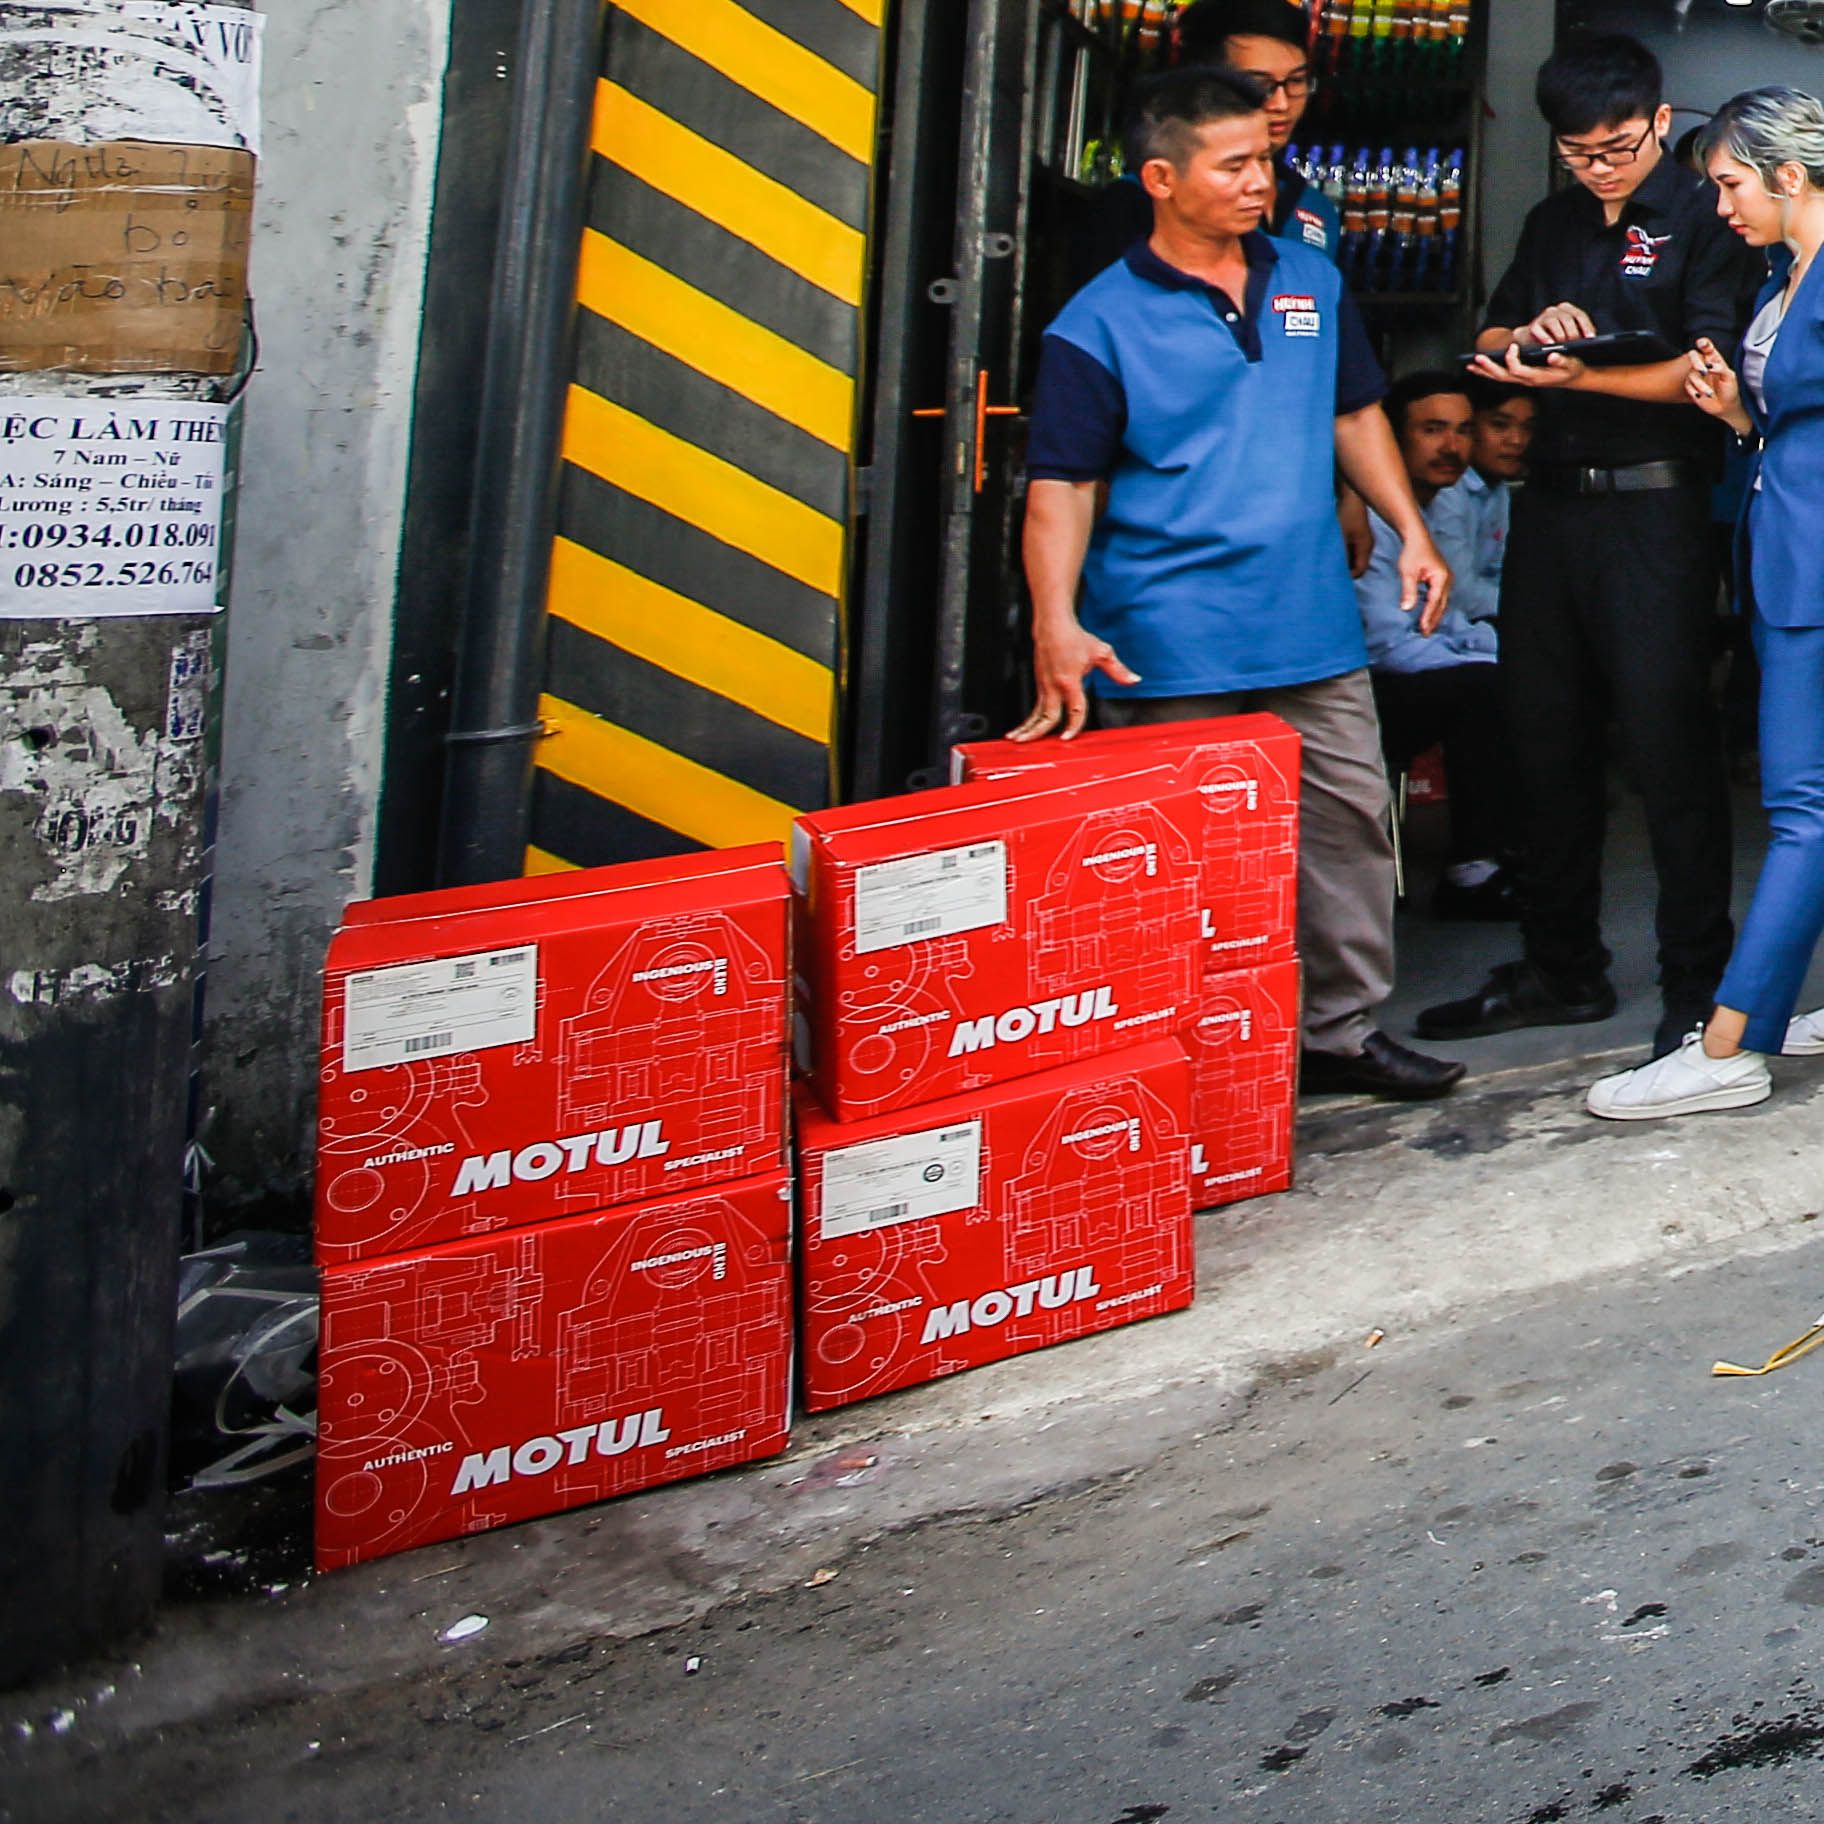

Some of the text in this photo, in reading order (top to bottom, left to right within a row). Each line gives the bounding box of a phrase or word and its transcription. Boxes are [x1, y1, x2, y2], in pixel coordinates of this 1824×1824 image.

[68, 411, 160, 441] LÀM
[53, 450, 182, 467] 7 Nam Nữ
[33, 471, 178, 493] Sáng Chiều
[160, 497, 203, 516] tháng
[1081, 845, 1145, 867] INGENIOUS
[632, 960, 714, 984] INGENIOUS
[713, 958, 728, 996] BLEND
[878, 1009, 952, 1036] AUTHENTIC
[947, 985, 1119, 1058] MOTUL
[1113, 1006, 1178, 1031] SPECIALIST
[1062, 1119, 1129, 1145] INGENIOUS
[363, 1141, 456, 1169] AUTHENTIC
[449, 1119, 671, 1198] MOTUL
[663, 1145, 746, 1172] SPECIALIST
[630, 1245, 714, 1272] INGENIOUS
[712, 1241, 727, 1281] BLEND
[848, 1294, 923, 1325] AUTHENTIC
[920, 1264, 1102, 1345] MOTUL
[1095, 1283, 1164, 1311] SPECIALIST
[362, 1440, 455, 1472] AUTHENTIC
[450, 1407, 673, 1496] MOTUL
[664, 1429, 747, 1460] SPECIALIST
